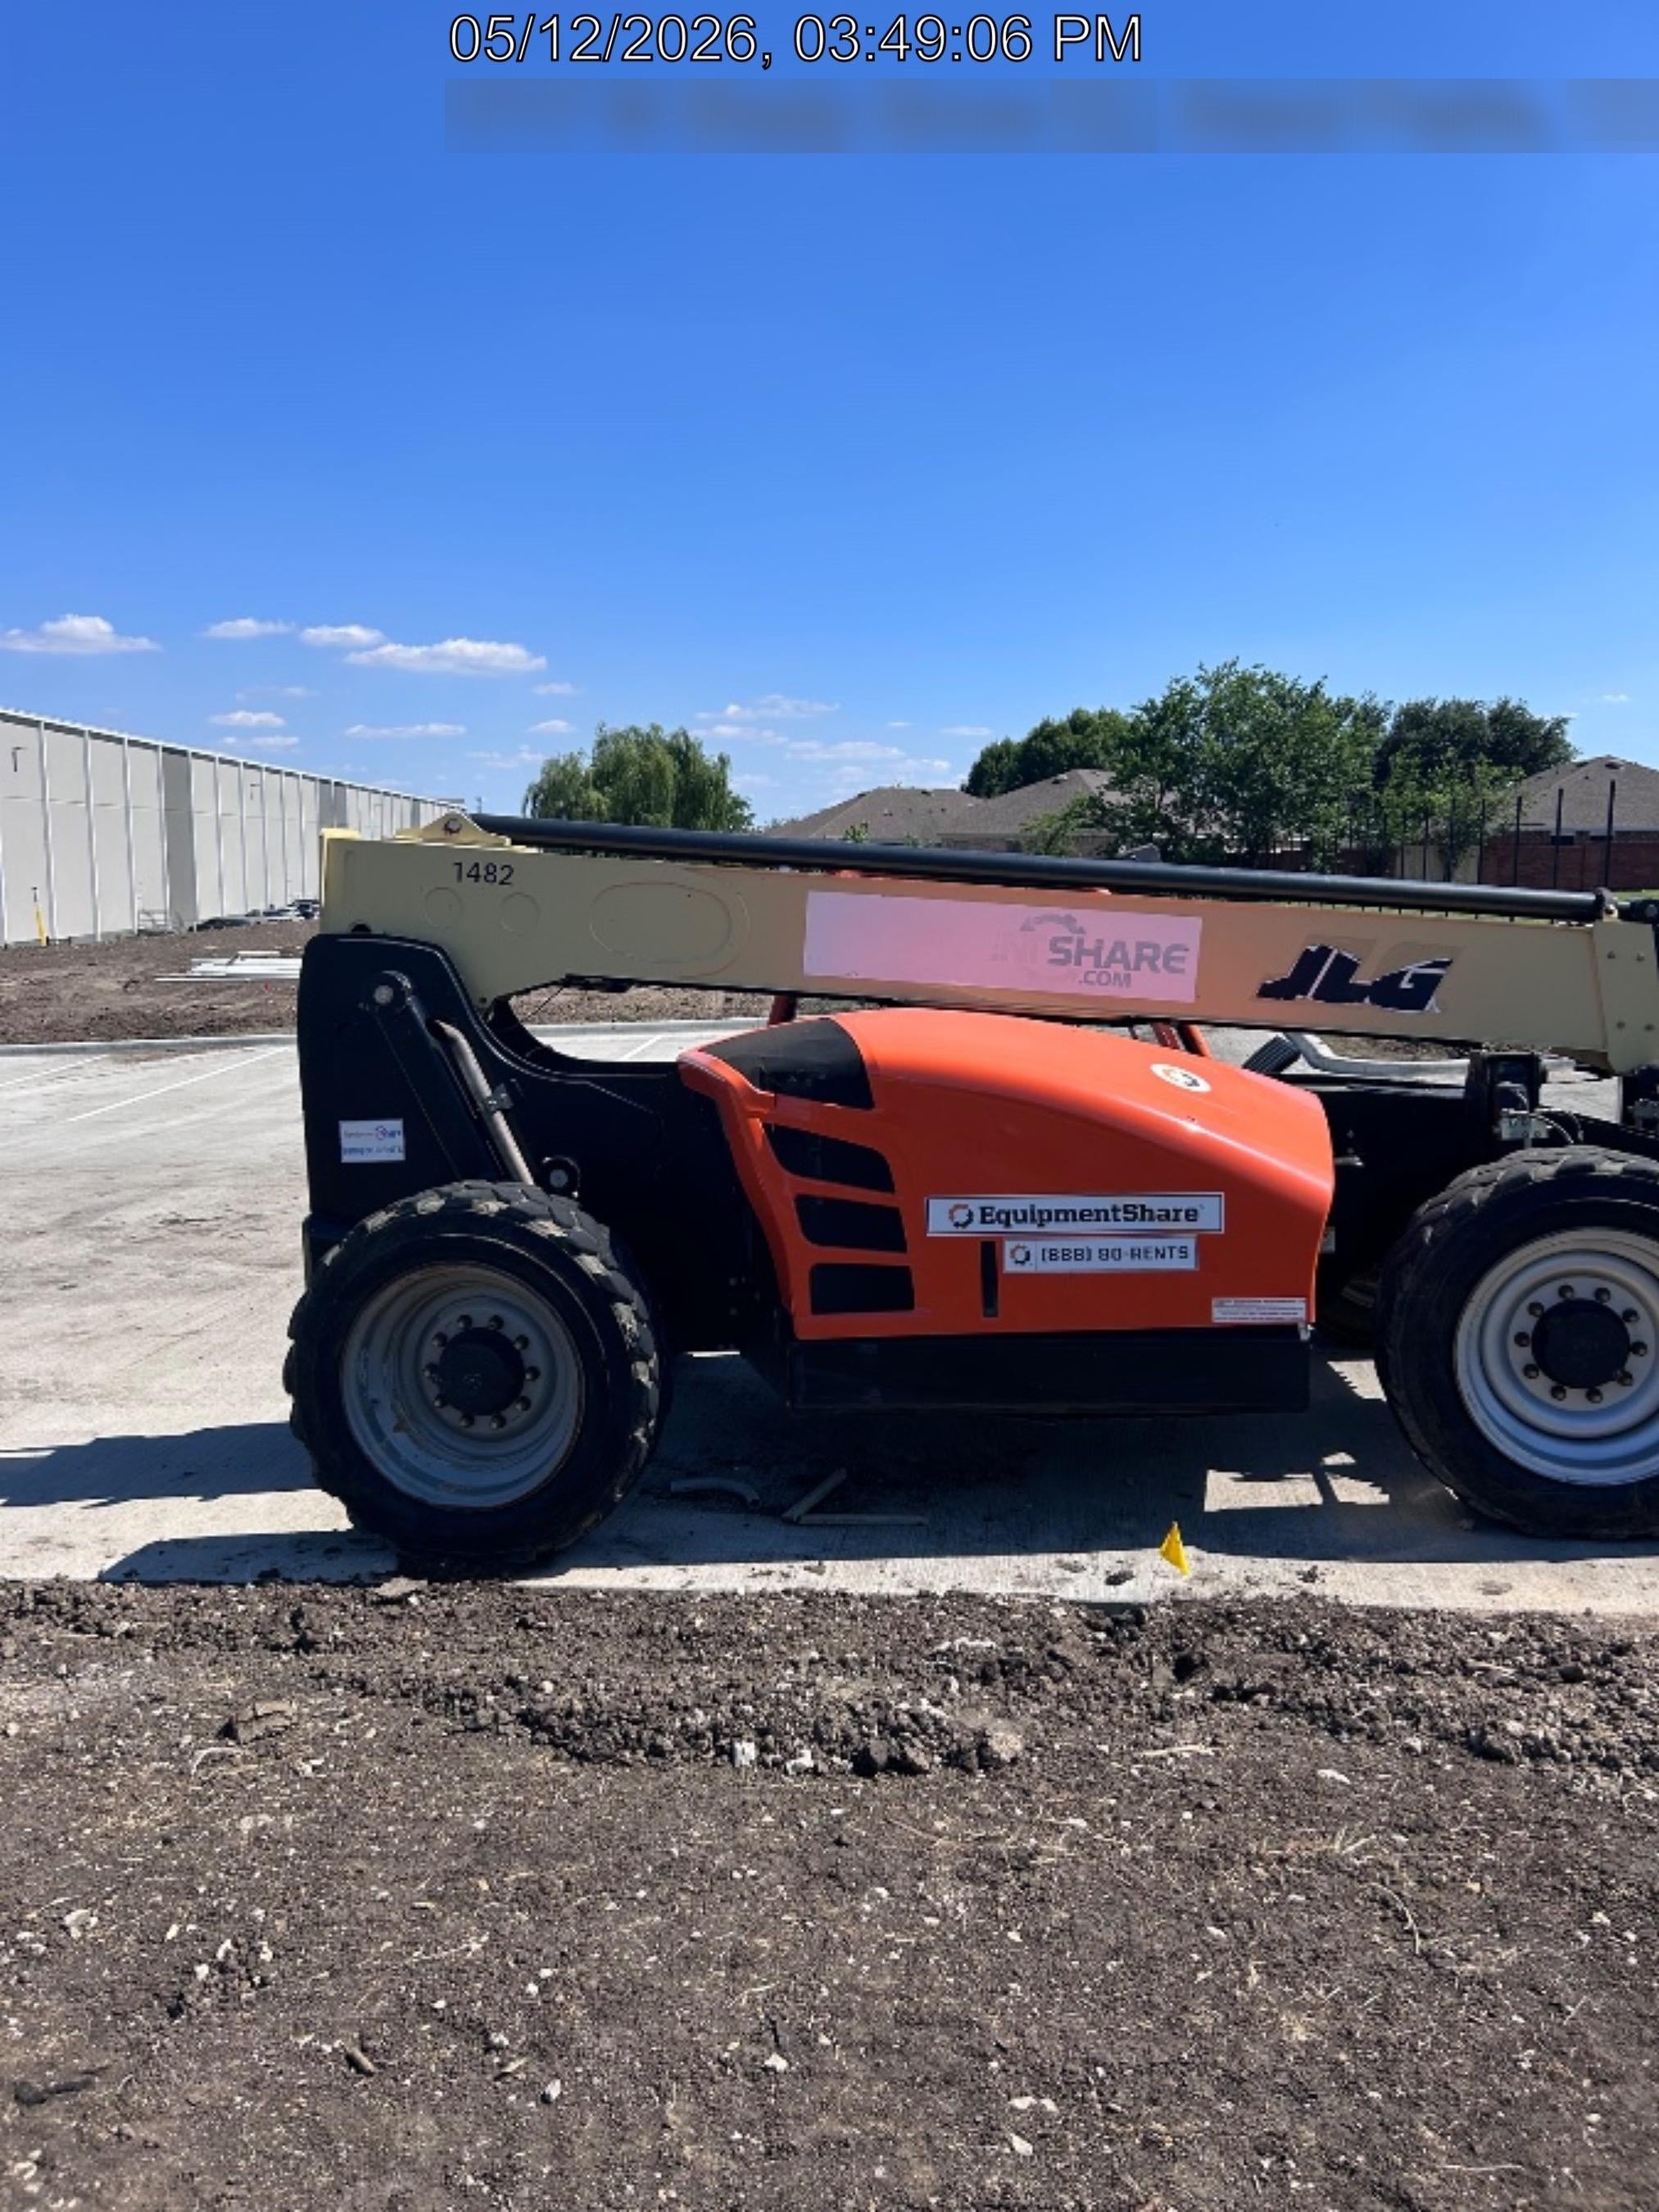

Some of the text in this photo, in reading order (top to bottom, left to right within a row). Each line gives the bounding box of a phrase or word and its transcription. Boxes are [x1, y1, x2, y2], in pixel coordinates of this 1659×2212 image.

[453, 862, 514, 886] 1482
[1257, 943, 1454, 1014] JLG
[980, 1203, 1199, 1227] EquipmentShare
